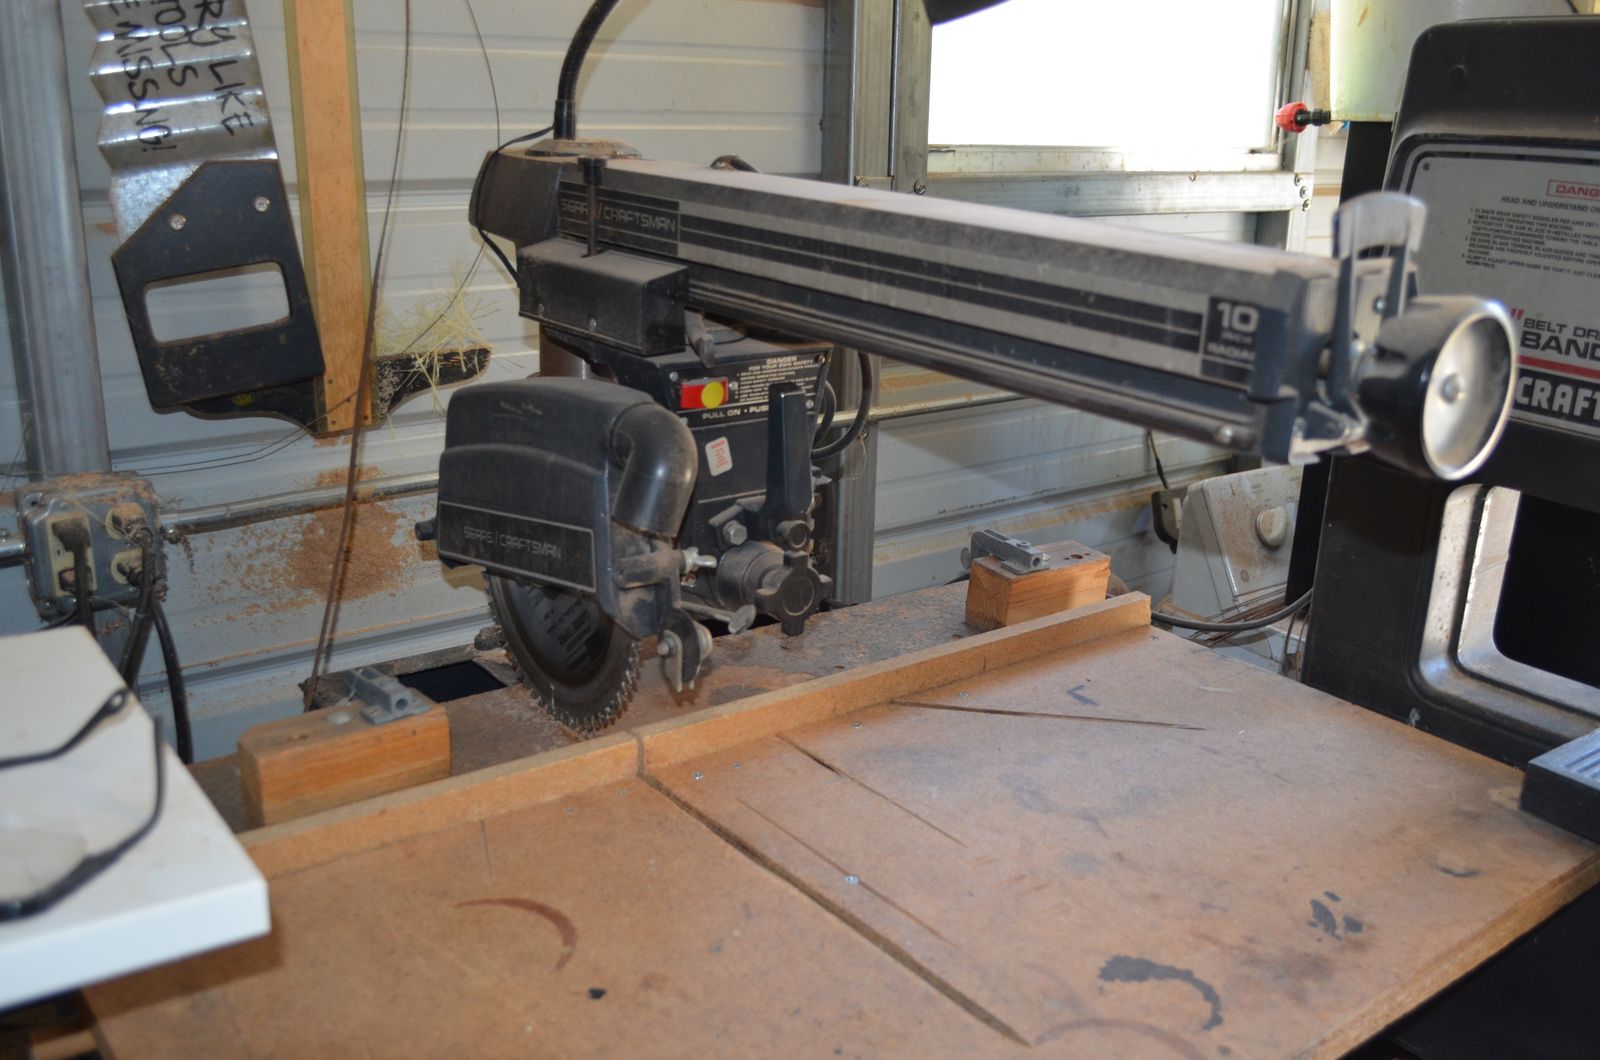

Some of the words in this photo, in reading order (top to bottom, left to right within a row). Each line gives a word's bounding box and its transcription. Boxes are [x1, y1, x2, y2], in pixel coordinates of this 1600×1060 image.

[113, 21, 178, 152] MISSNG!
[209, 60, 254, 136] LIKE
[561, 200, 589, 214] SEAR
[603, 206, 676, 232] CRAFTSMAN
[1521, 198, 1536, 207] AND
[1538, 200, 1588, 213] UNDERSTAND
[1217, 302, 1260, 333] 10
[1523, 318, 1567, 334] BELT
[1573, 326, 1600, 341] DR
[702, 411, 725, 419] PULL
[727, 408, 741, 416] ON
[463, 526, 494, 544] SEARS
[499, 534, 561, 558] CRAFTSMAN
